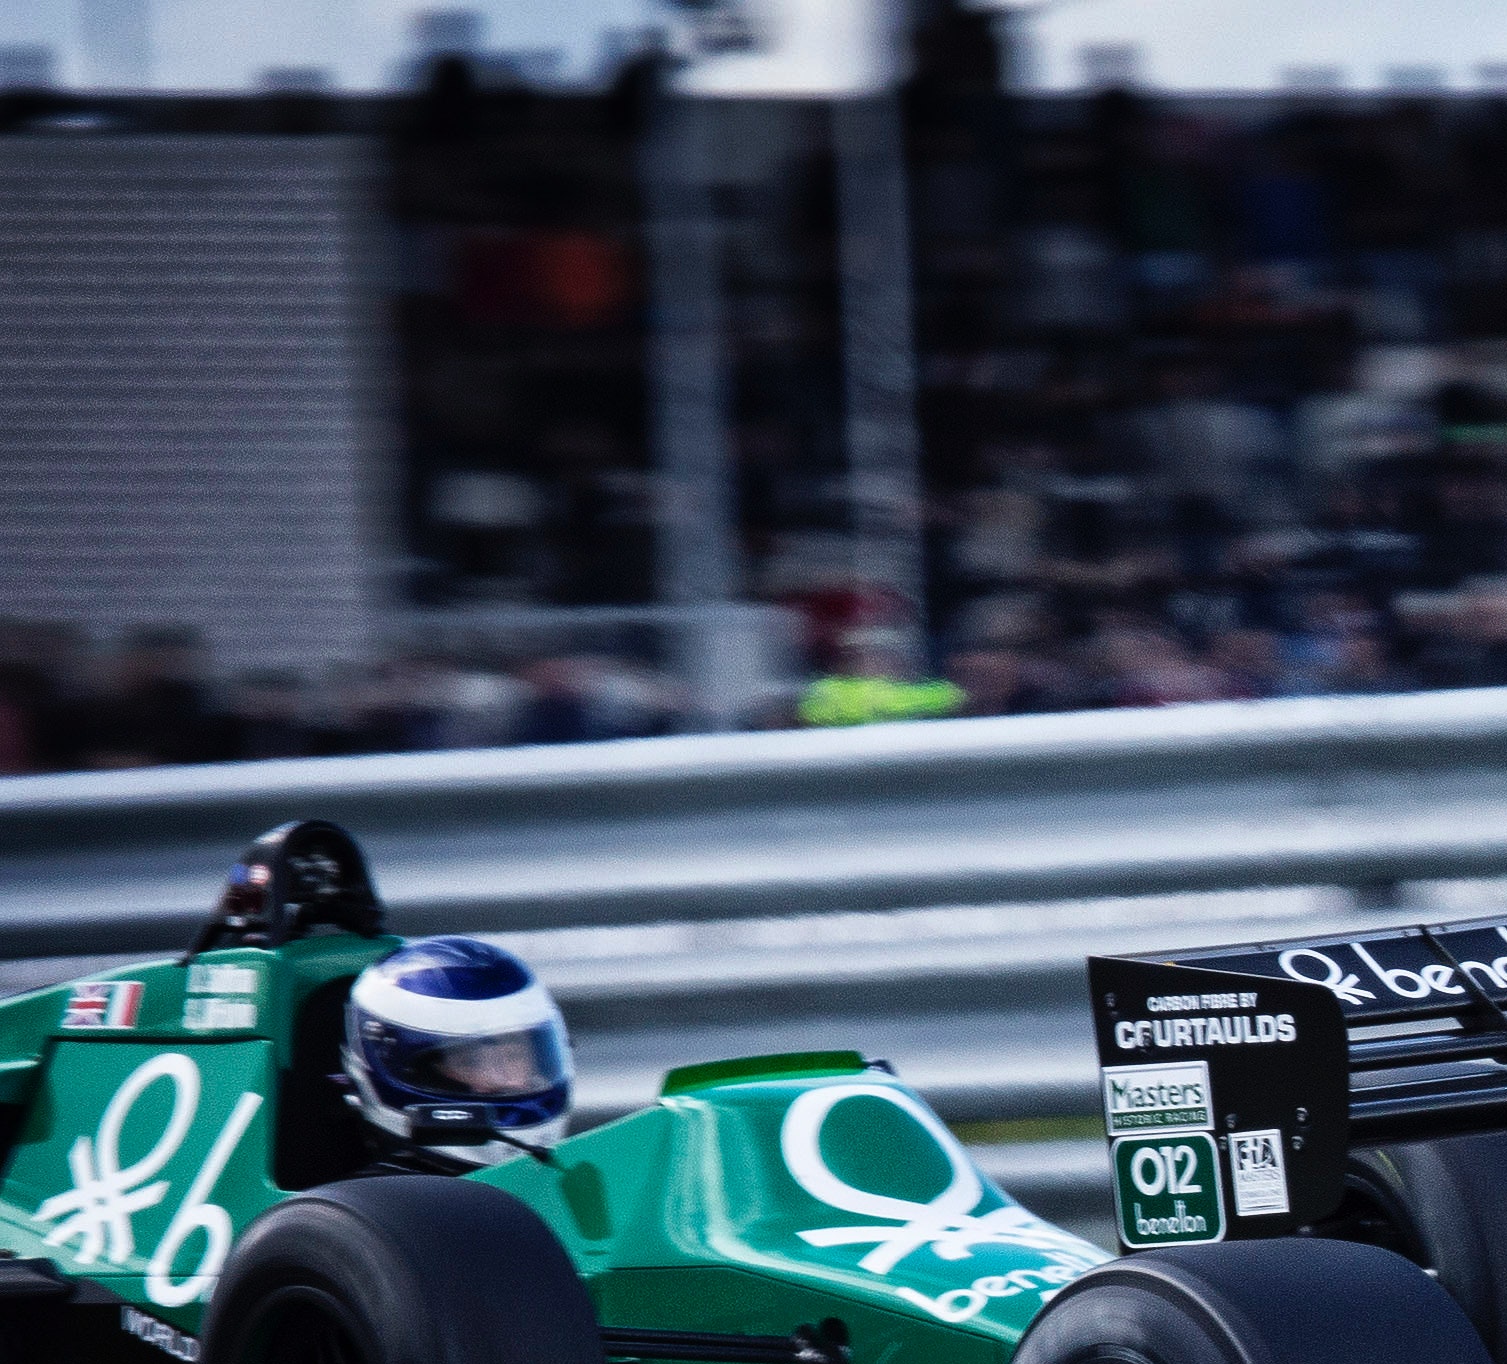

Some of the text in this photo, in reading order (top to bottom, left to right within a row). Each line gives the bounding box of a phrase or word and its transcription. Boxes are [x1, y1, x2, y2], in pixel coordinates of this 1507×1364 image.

[1147, 992, 1257, 1012] CARBON FIBRE BY
[1111, 1078, 1204, 1109] Masters
[1165, 1109, 1207, 1123] RACING
[1131, 1145, 1202, 1196] 012
[1134, 1200, 1208, 1235] benetton
